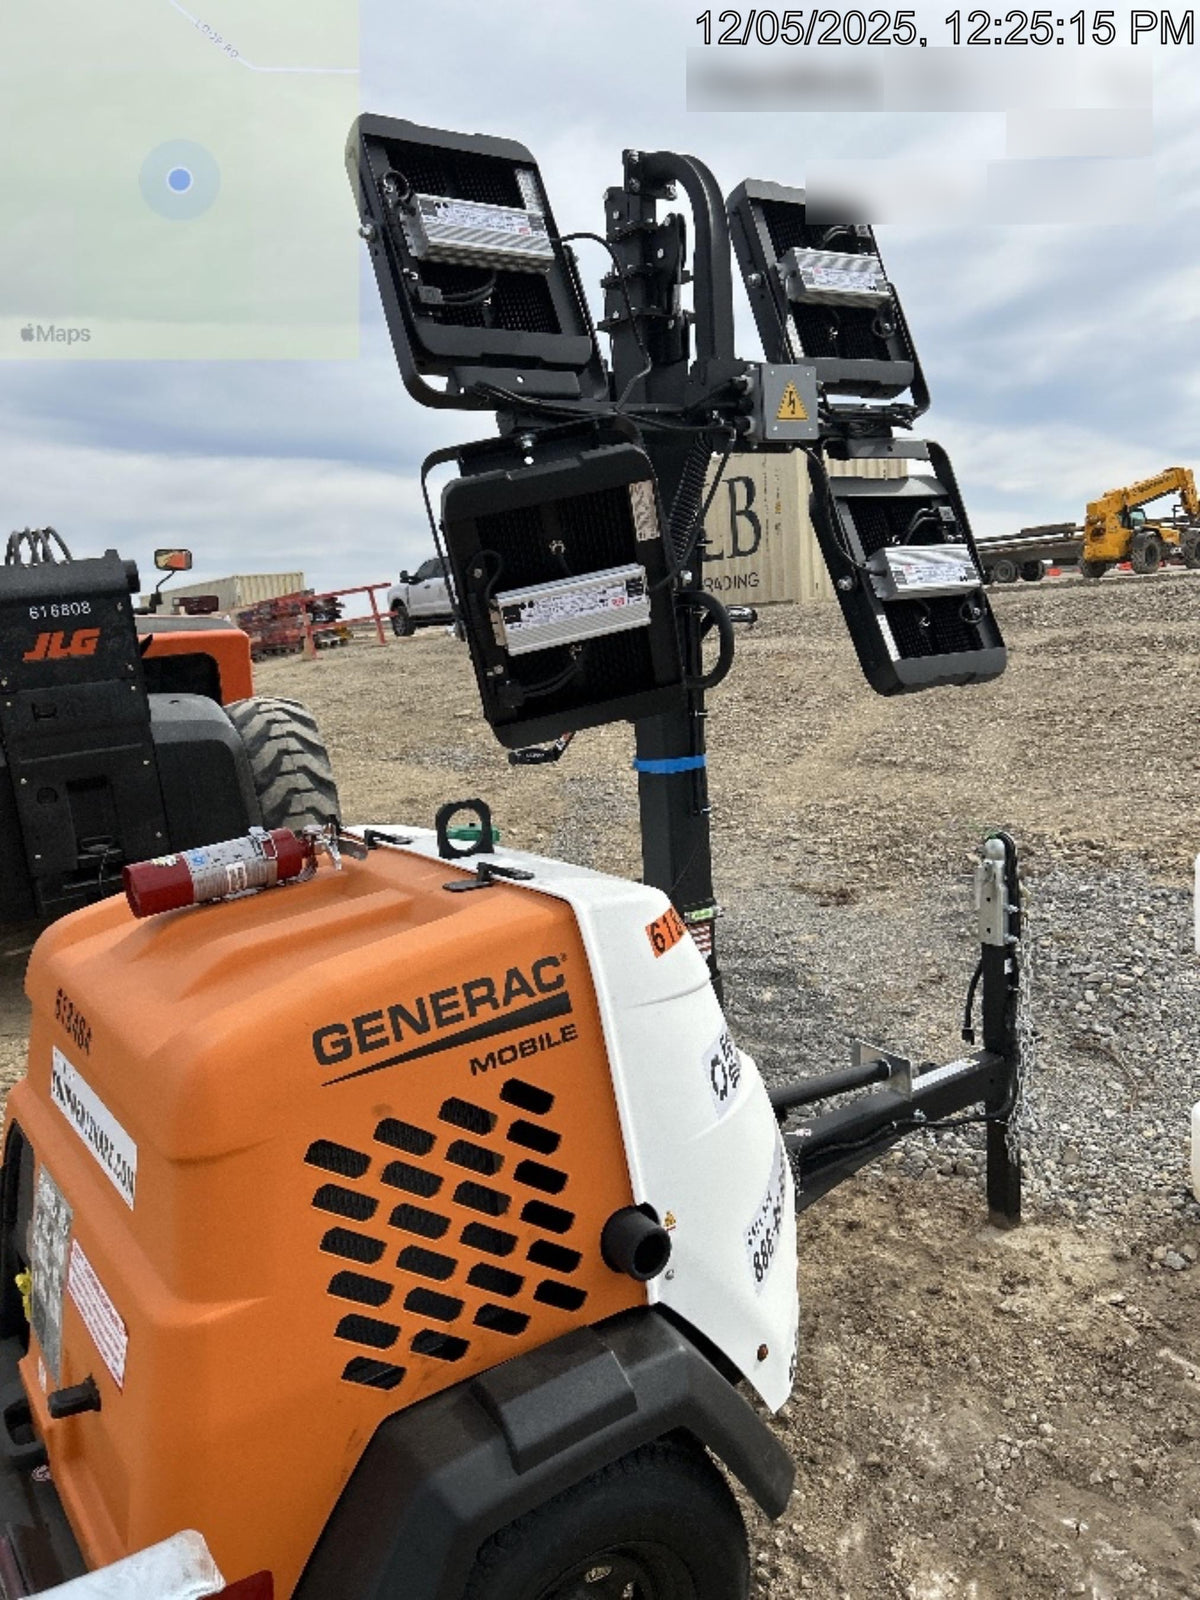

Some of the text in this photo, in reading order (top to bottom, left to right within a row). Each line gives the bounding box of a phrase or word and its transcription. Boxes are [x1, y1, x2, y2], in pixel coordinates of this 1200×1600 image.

[22, 628, 101, 662] JLG
[312, 955, 566, 1066] GENERAC
[469, 1023, 579, 1076] MOBILE
